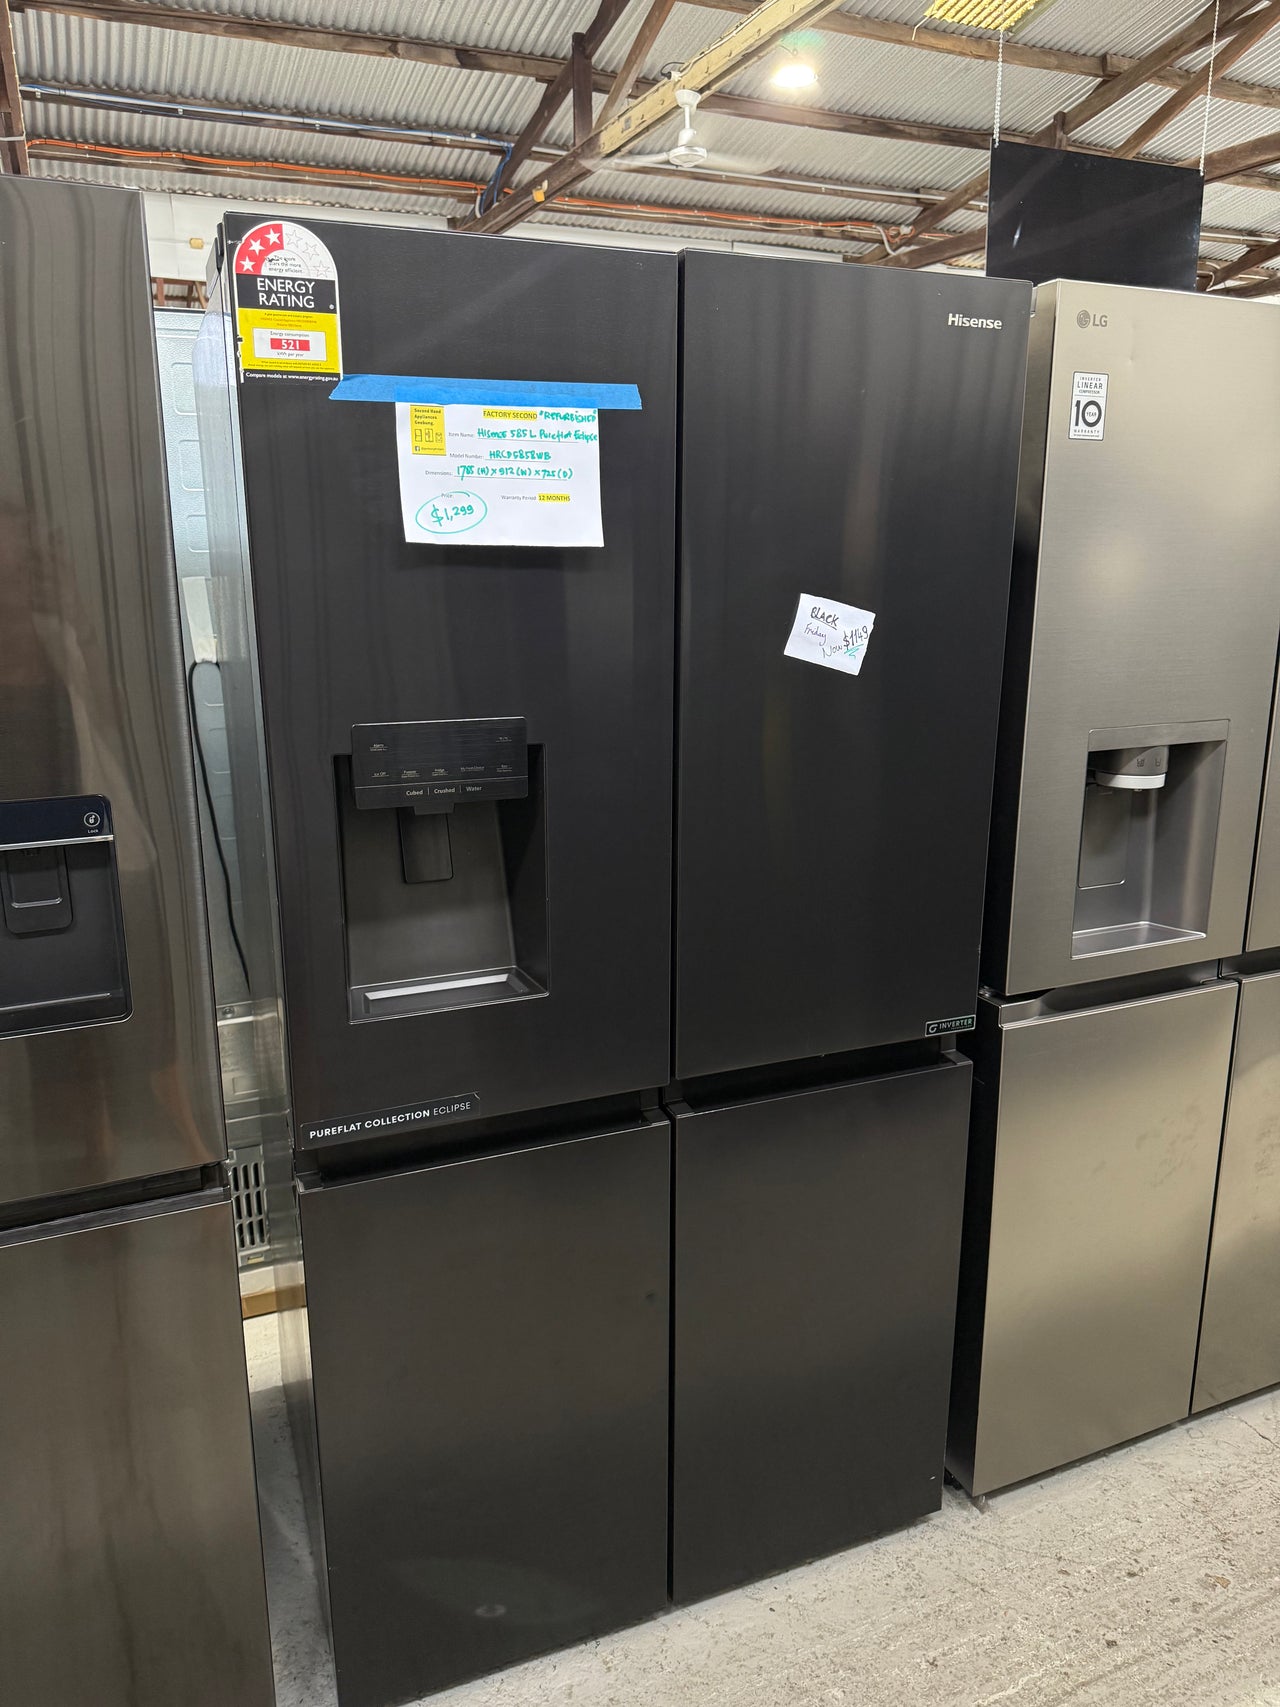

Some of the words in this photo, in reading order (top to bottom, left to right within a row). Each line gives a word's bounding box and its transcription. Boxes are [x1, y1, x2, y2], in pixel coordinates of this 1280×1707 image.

[257, 278, 315, 294] ENERGY
[258, 292, 314, 308] RATING
[948, 313, 1002, 329] Hisense
[1092, 314, 1108, 328] LG
[282, 340, 300, 350] 521
[1077, 381, 1103, 390] LINEAR
[1074, 400, 1102, 428] 10
[510, 428, 528, 438] 585
[530, 429, 536, 438] L
[498, 467, 514, 475] 912
[431, 504, 474, 527] $1,299
[811, 606, 840, 627] BLACK
[804, 622, 827, 646] Friday
[940, 1018, 972, 1030] INVERTER
[309, 1122, 362, 1139] PUREFLAT
[364, 1110, 430, 1129] COLLECTION
[433, 1101, 471, 1116] ECLIPSE
